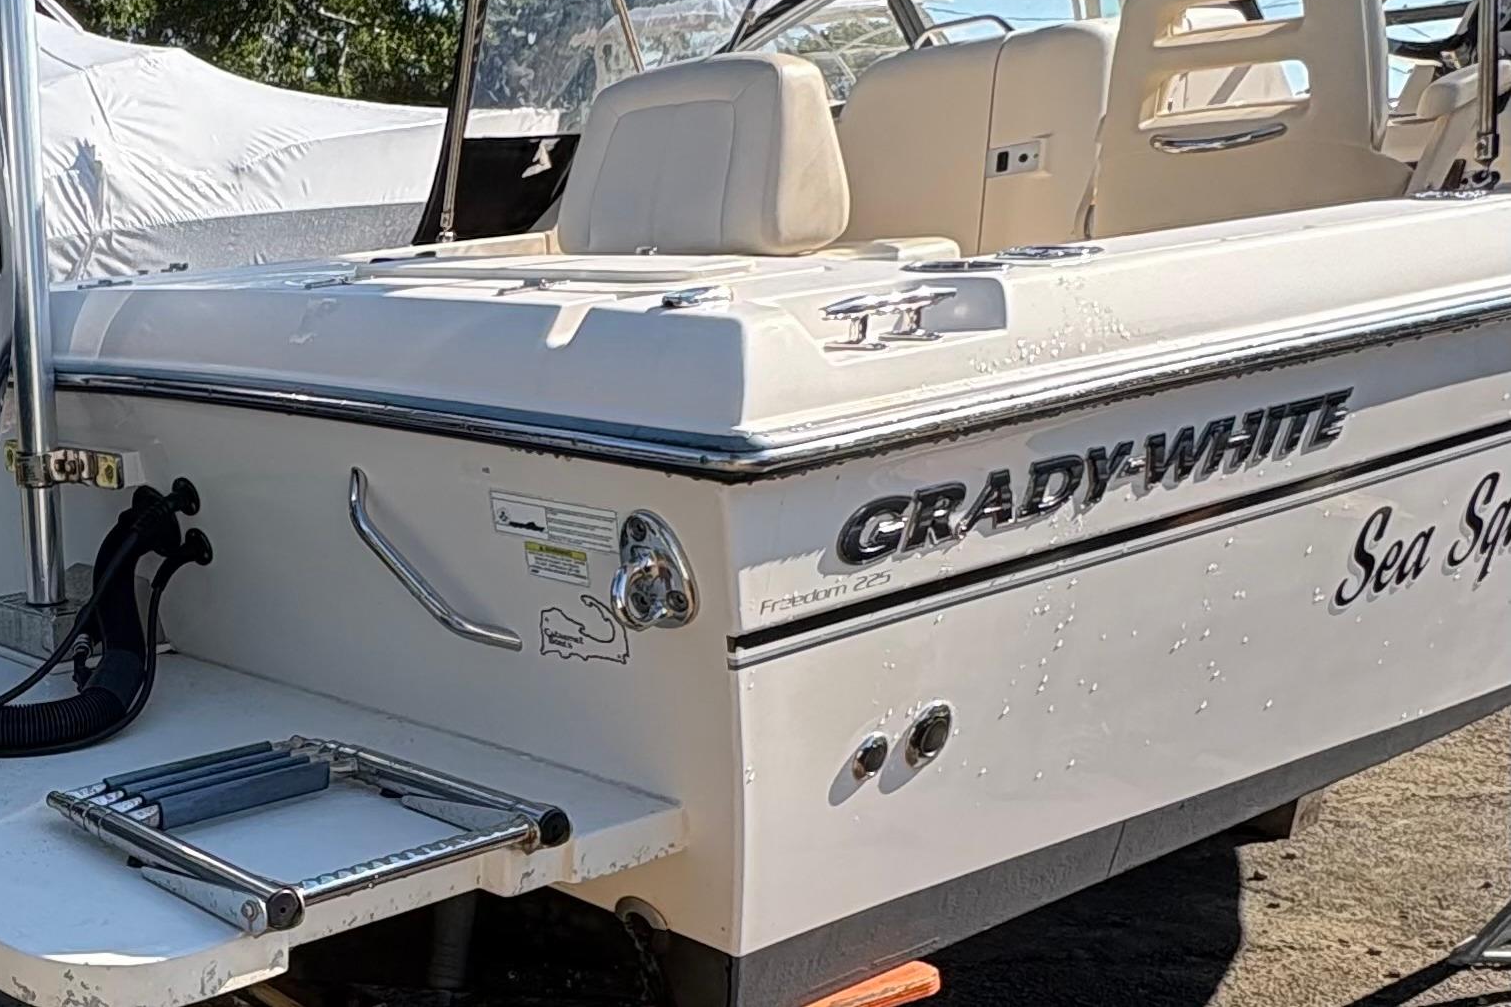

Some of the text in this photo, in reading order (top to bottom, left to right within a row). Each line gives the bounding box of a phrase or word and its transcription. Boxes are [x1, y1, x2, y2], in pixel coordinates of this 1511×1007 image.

[836, 387, 1353, 567] GRADY-WHITE
[760, 570, 892, 615] Freedom 225
[1334, 506, 1436, 607] Sea
